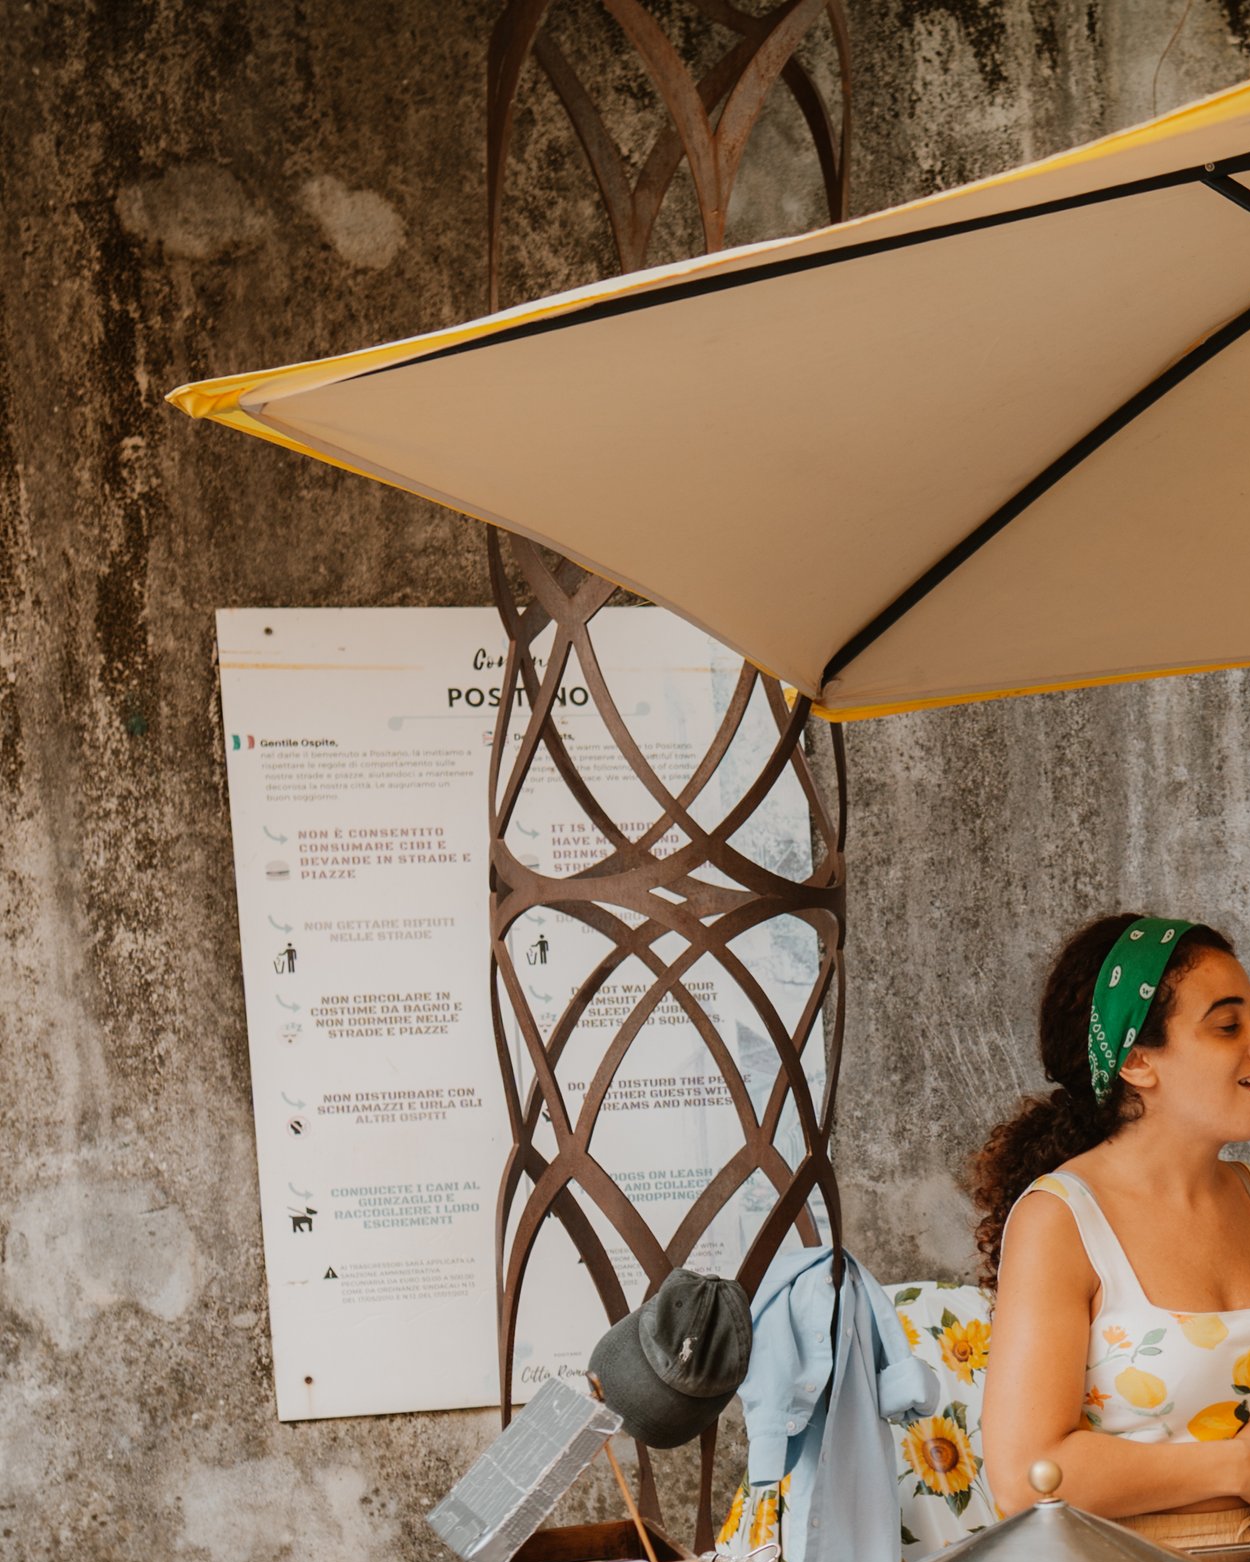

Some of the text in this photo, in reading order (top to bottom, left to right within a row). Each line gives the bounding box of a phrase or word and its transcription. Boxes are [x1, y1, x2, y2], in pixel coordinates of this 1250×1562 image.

[260, 737, 339, 748] Gentile Ospite,
[298, 827, 445, 839] NON È CONSENTITO
[571, 824, 585, 833] IS
[299, 840, 446, 853] CONSUMARE CIBI E
[552, 837, 590, 846] HAVE
[300, 853, 472, 867] BEVANDE IN STRADE E
[553, 849, 607, 859] DRINKS
[301, 869, 356, 880] PIAZZE
[304, 917, 455, 932] NON GETTARE RIFIUTI
[330, 930, 432, 943] NELLE STRADE
[321, 992, 451, 1005] NON CIRCOLARE IN
[310, 1002, 463, 1017] COSTUME DA BAGNO E
[316, 1013, 459, 1028] NON DORMIRE NELLE
[328, 1025, 448, 1039] STRADE E PIAZZE
[568, 1082, 585, 1091] DO
[619, 1077, 676, 1088] DISTURB
[680, 1076, 705, 1086] THE
[323, 1088, 475, 1103] NON DISTURBARE CON
[650, 1087, 701, 1098] GUESTS
[705, 1086, 728, 1096] WIT
[317, 1098, 483, 1115] SCHIAMAZZI E URLA GLI
[654, 1099, 680, 1108] AND
[355, 1111, 447, 1125] ALTRI OSPITI
[649, 1170, 666, 1180] ON
[670, 1168, 713, 1178] LEASH
[331, 1181, 481, 1198] CONDUCETE I CANI AL
[624, 1181, 651, 1192] AND
[359, 1193, 455, 1207] GUINZAGLIO E
[334, 1203, 480, 1220] RACCOGLIERE I LORO
[364, 1216, 453, 1229] ESCREMENTI
